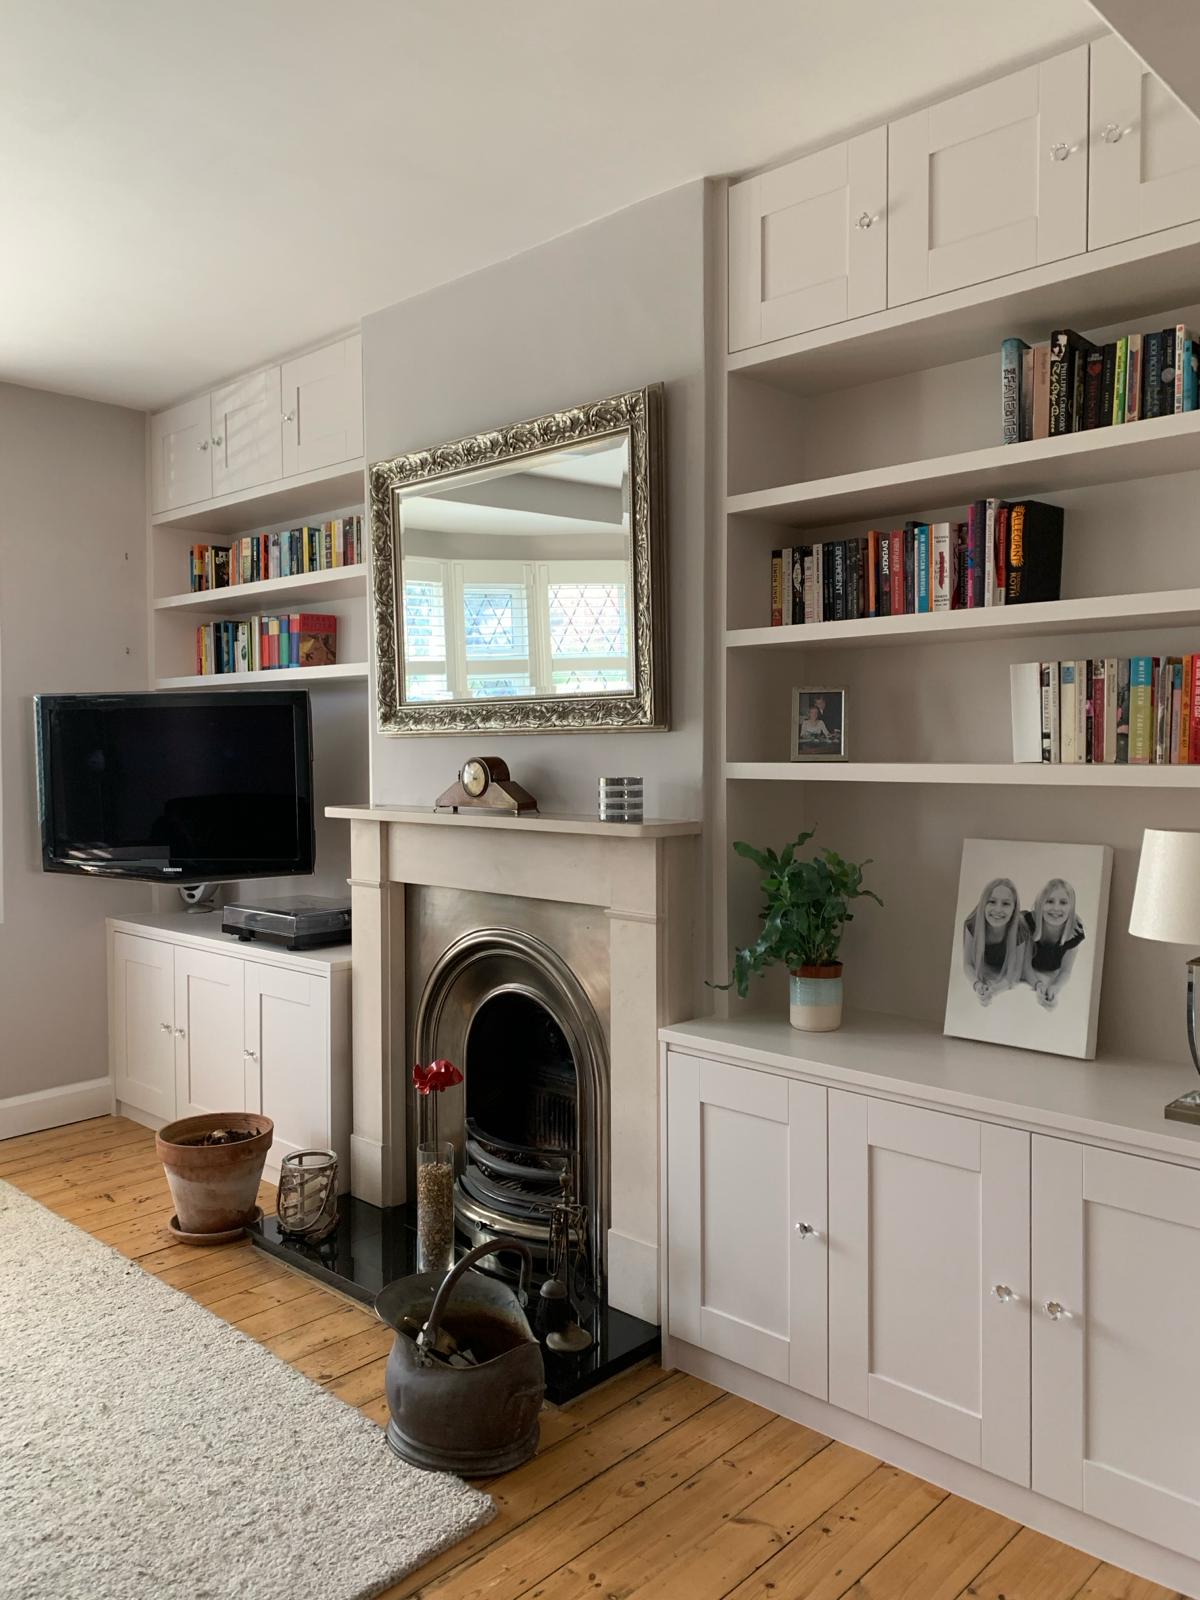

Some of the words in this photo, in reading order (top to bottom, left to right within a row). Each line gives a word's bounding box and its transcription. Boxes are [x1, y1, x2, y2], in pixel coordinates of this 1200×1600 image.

[1059, 362, 1068, 397] PHILIPPA
[1150, 356, 1158, 385] PICOULT
[1058, 397, 1067, 432] GREGORY
[1010, 509, 1025, 563] ALLEGIANT
[835, 546, 843, 595] DIVERGENT
[1008, 572, 1019, 597] ROTH
